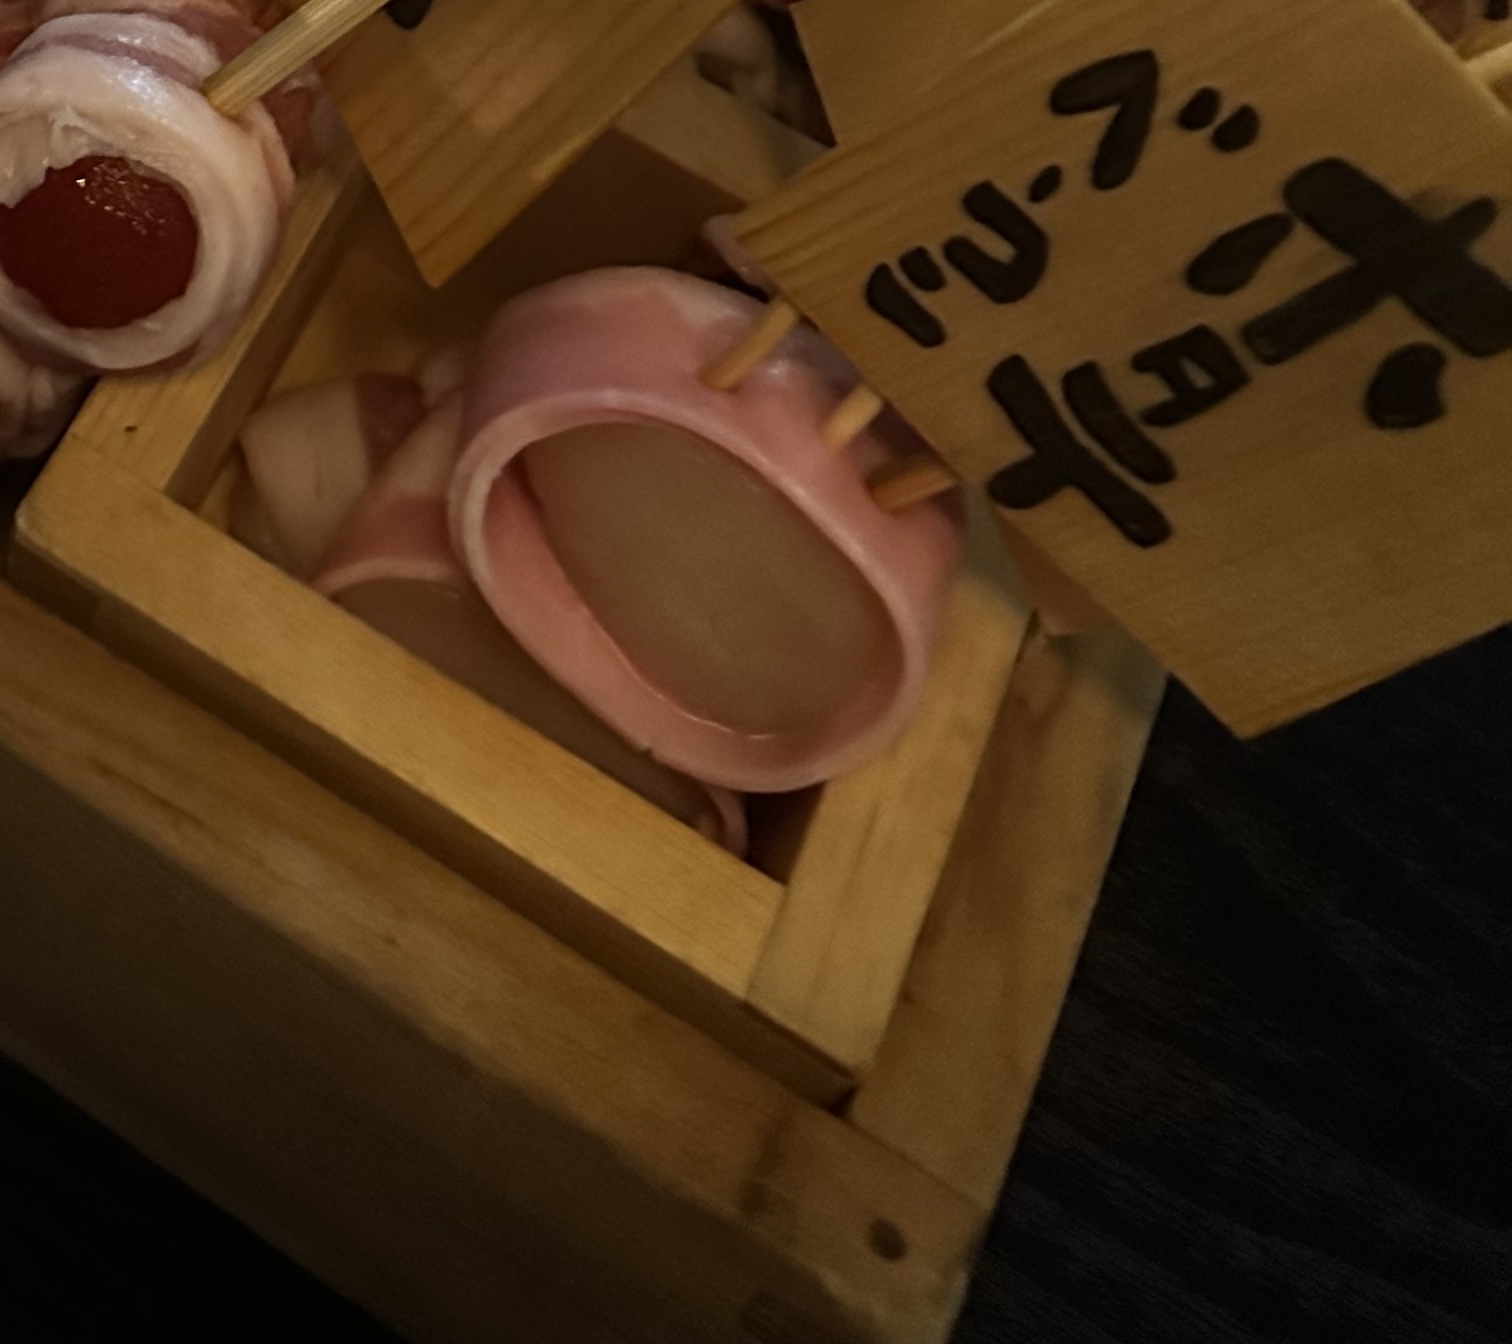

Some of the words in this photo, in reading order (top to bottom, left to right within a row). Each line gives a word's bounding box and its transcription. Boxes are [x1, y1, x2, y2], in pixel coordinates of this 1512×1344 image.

[867, 49, 1260, 346] ベーコン
[985, 158, 1512, 548] ホタテ
